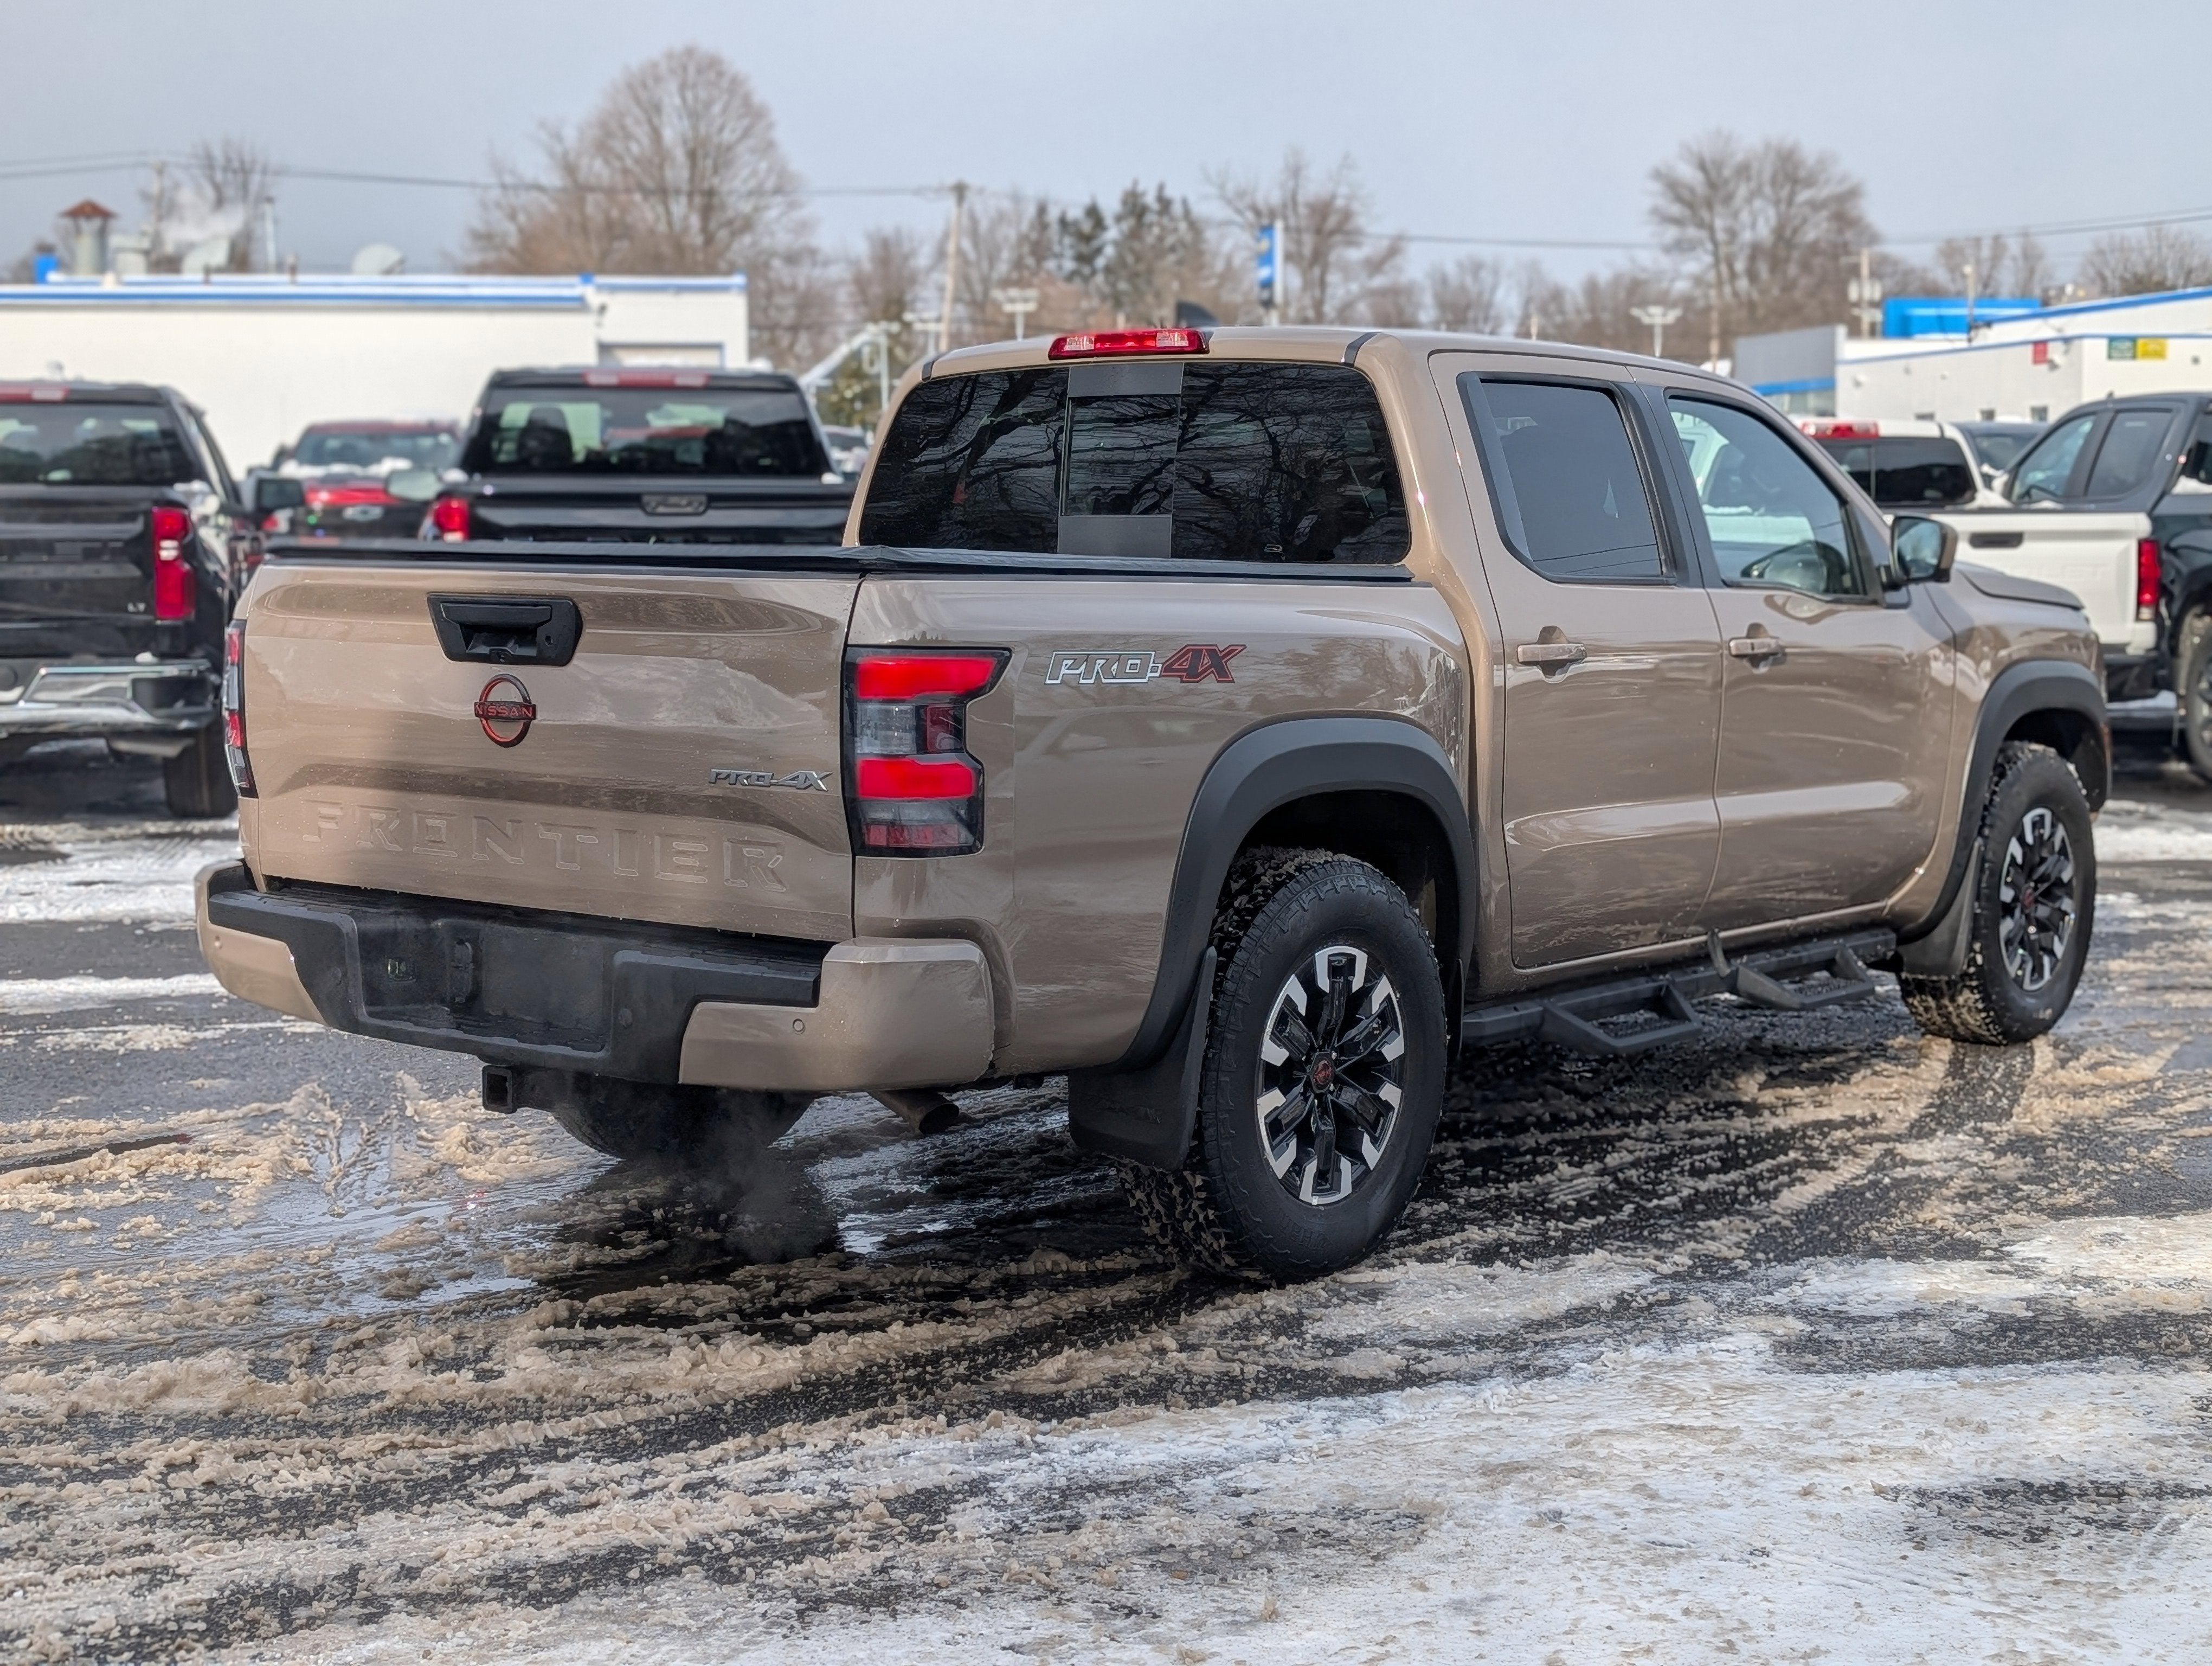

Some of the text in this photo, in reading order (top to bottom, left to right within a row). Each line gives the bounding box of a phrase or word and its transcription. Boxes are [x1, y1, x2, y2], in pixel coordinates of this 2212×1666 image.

[1044, 644, 1247, 684] PRO-4X
[475, 705, 532, 717] NISSAN
[709, 768, 833, 791] PRO-4X
[301, 799, 787, 892] FRONTIER
